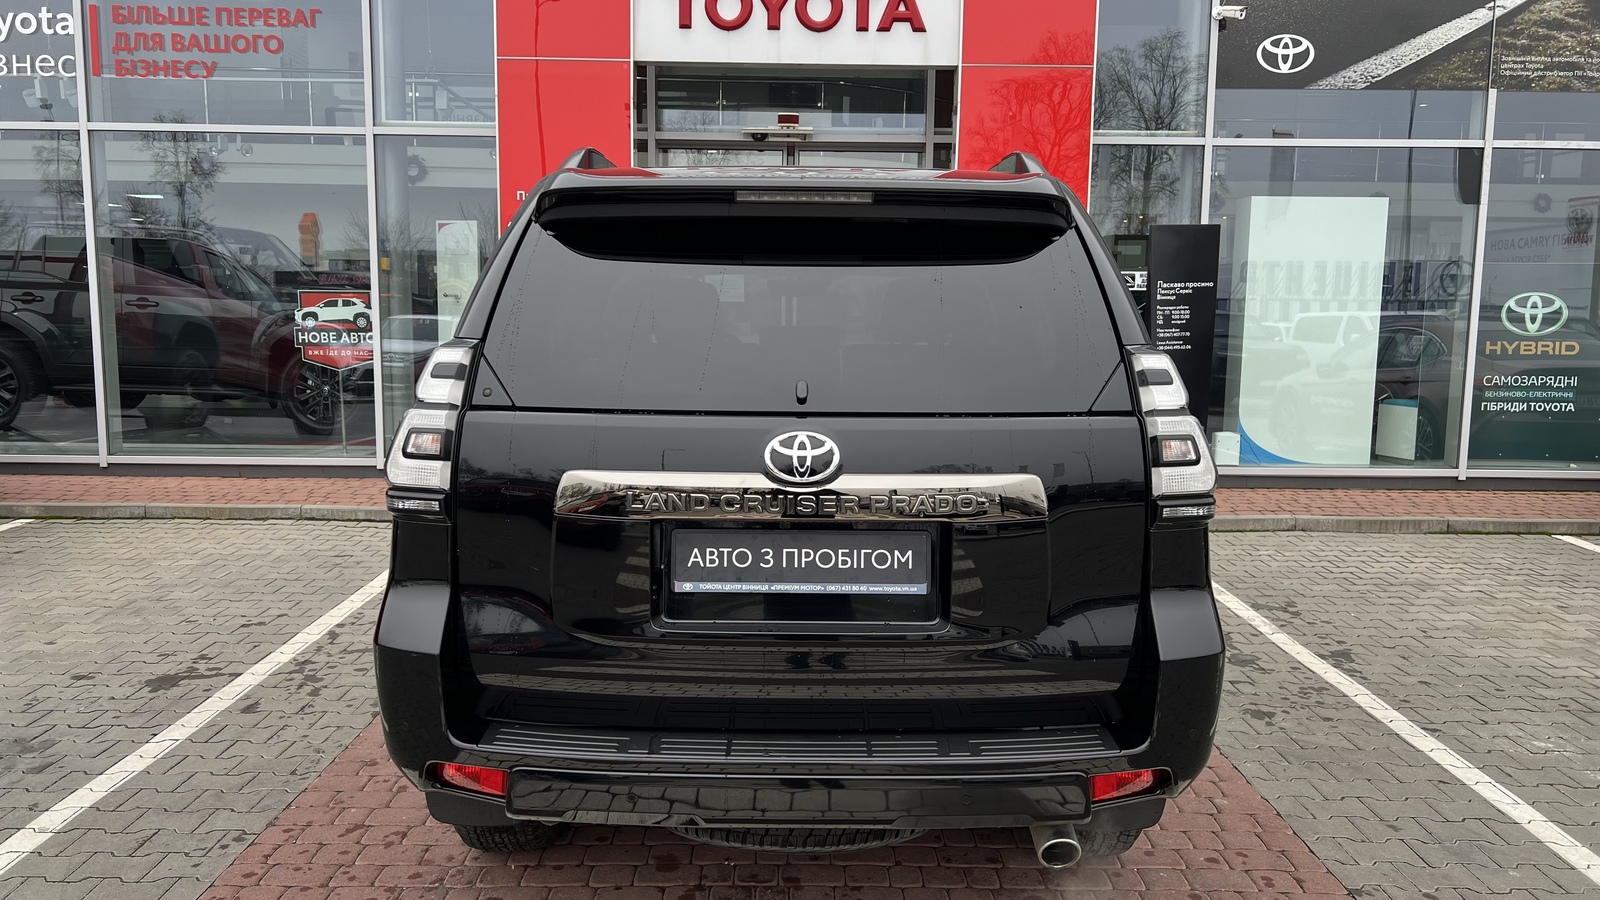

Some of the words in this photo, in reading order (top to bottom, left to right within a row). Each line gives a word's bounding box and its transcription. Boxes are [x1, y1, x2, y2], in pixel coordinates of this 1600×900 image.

[112, 4, 208, 25] БІЛЬШЕ
[215, 7, 321, 27] ПЕРЕВАГ
[112, 32, 163, 54] ДЛЯ
[171, 33, 283, 54] ВАШОГО
[114, 59, 217, 79] БІЗНЕСУ
[1491, 239, 1515, 251] НОВА
[1518, 235, 1550, 249] CAMRY
[298, 332, 336, 343] НОВЕ
[341, 332, 374, 344] АВТО
[326, 349, 338, 357] ЇДЕ
[1485, 341, 1580, 355] HYBRID
[1483, 375, 1578, 388] САМОЗАРЯДНІ
[1481, 402, 1527, 412] ГІБРИДИ
[1529, 402, 1575, 412] TOYOTA
[626, 491, 709, 514] LAND
[719, 494, 860, 515] CRUISER
[869, 494, 978, 515] PRADO
[687, 548, 752, 569] АВТО
[760, 548, 774, 569] З
[782, 548, 913, 570] ПРОБІГОМ
